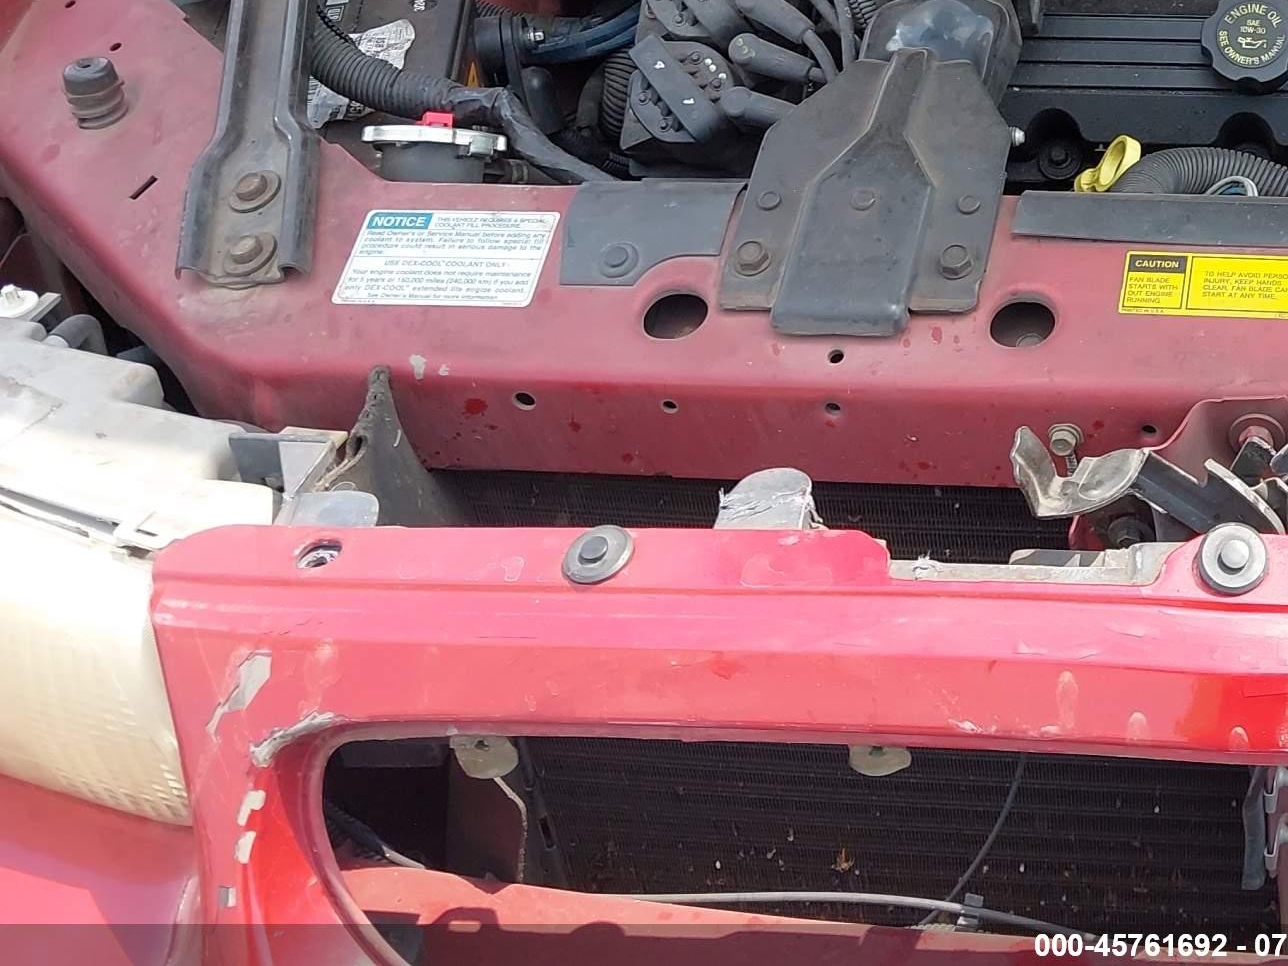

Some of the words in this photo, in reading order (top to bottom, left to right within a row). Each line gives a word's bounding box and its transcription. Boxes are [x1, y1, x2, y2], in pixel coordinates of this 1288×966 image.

[1224, 3, 1268, 24] ENGINE
[1267, 10, 1283, 28] OIL
[1246, 19, 1261, 27] SAE
[1239, 26, 1266, 34] 10W-30
[1219, 30, 1230, 47] SEE
[1260, 34, 1286, 63] MANUAL
[1224, 46, 1260, 65] OWNER'S
[653, 60, 666, 70] 4
[682, 97, 695, 105] 1
[372, 216, 427, 227] NOTICE
[445, 260, 485, 268] COOLANT
[1135, 259, 1180, 268] CAUTION
[1145, 290, 1174, 298] ENGINE
[1202, 291, 1226, 299] START
[1239, 292, 1257, 300] ANY
